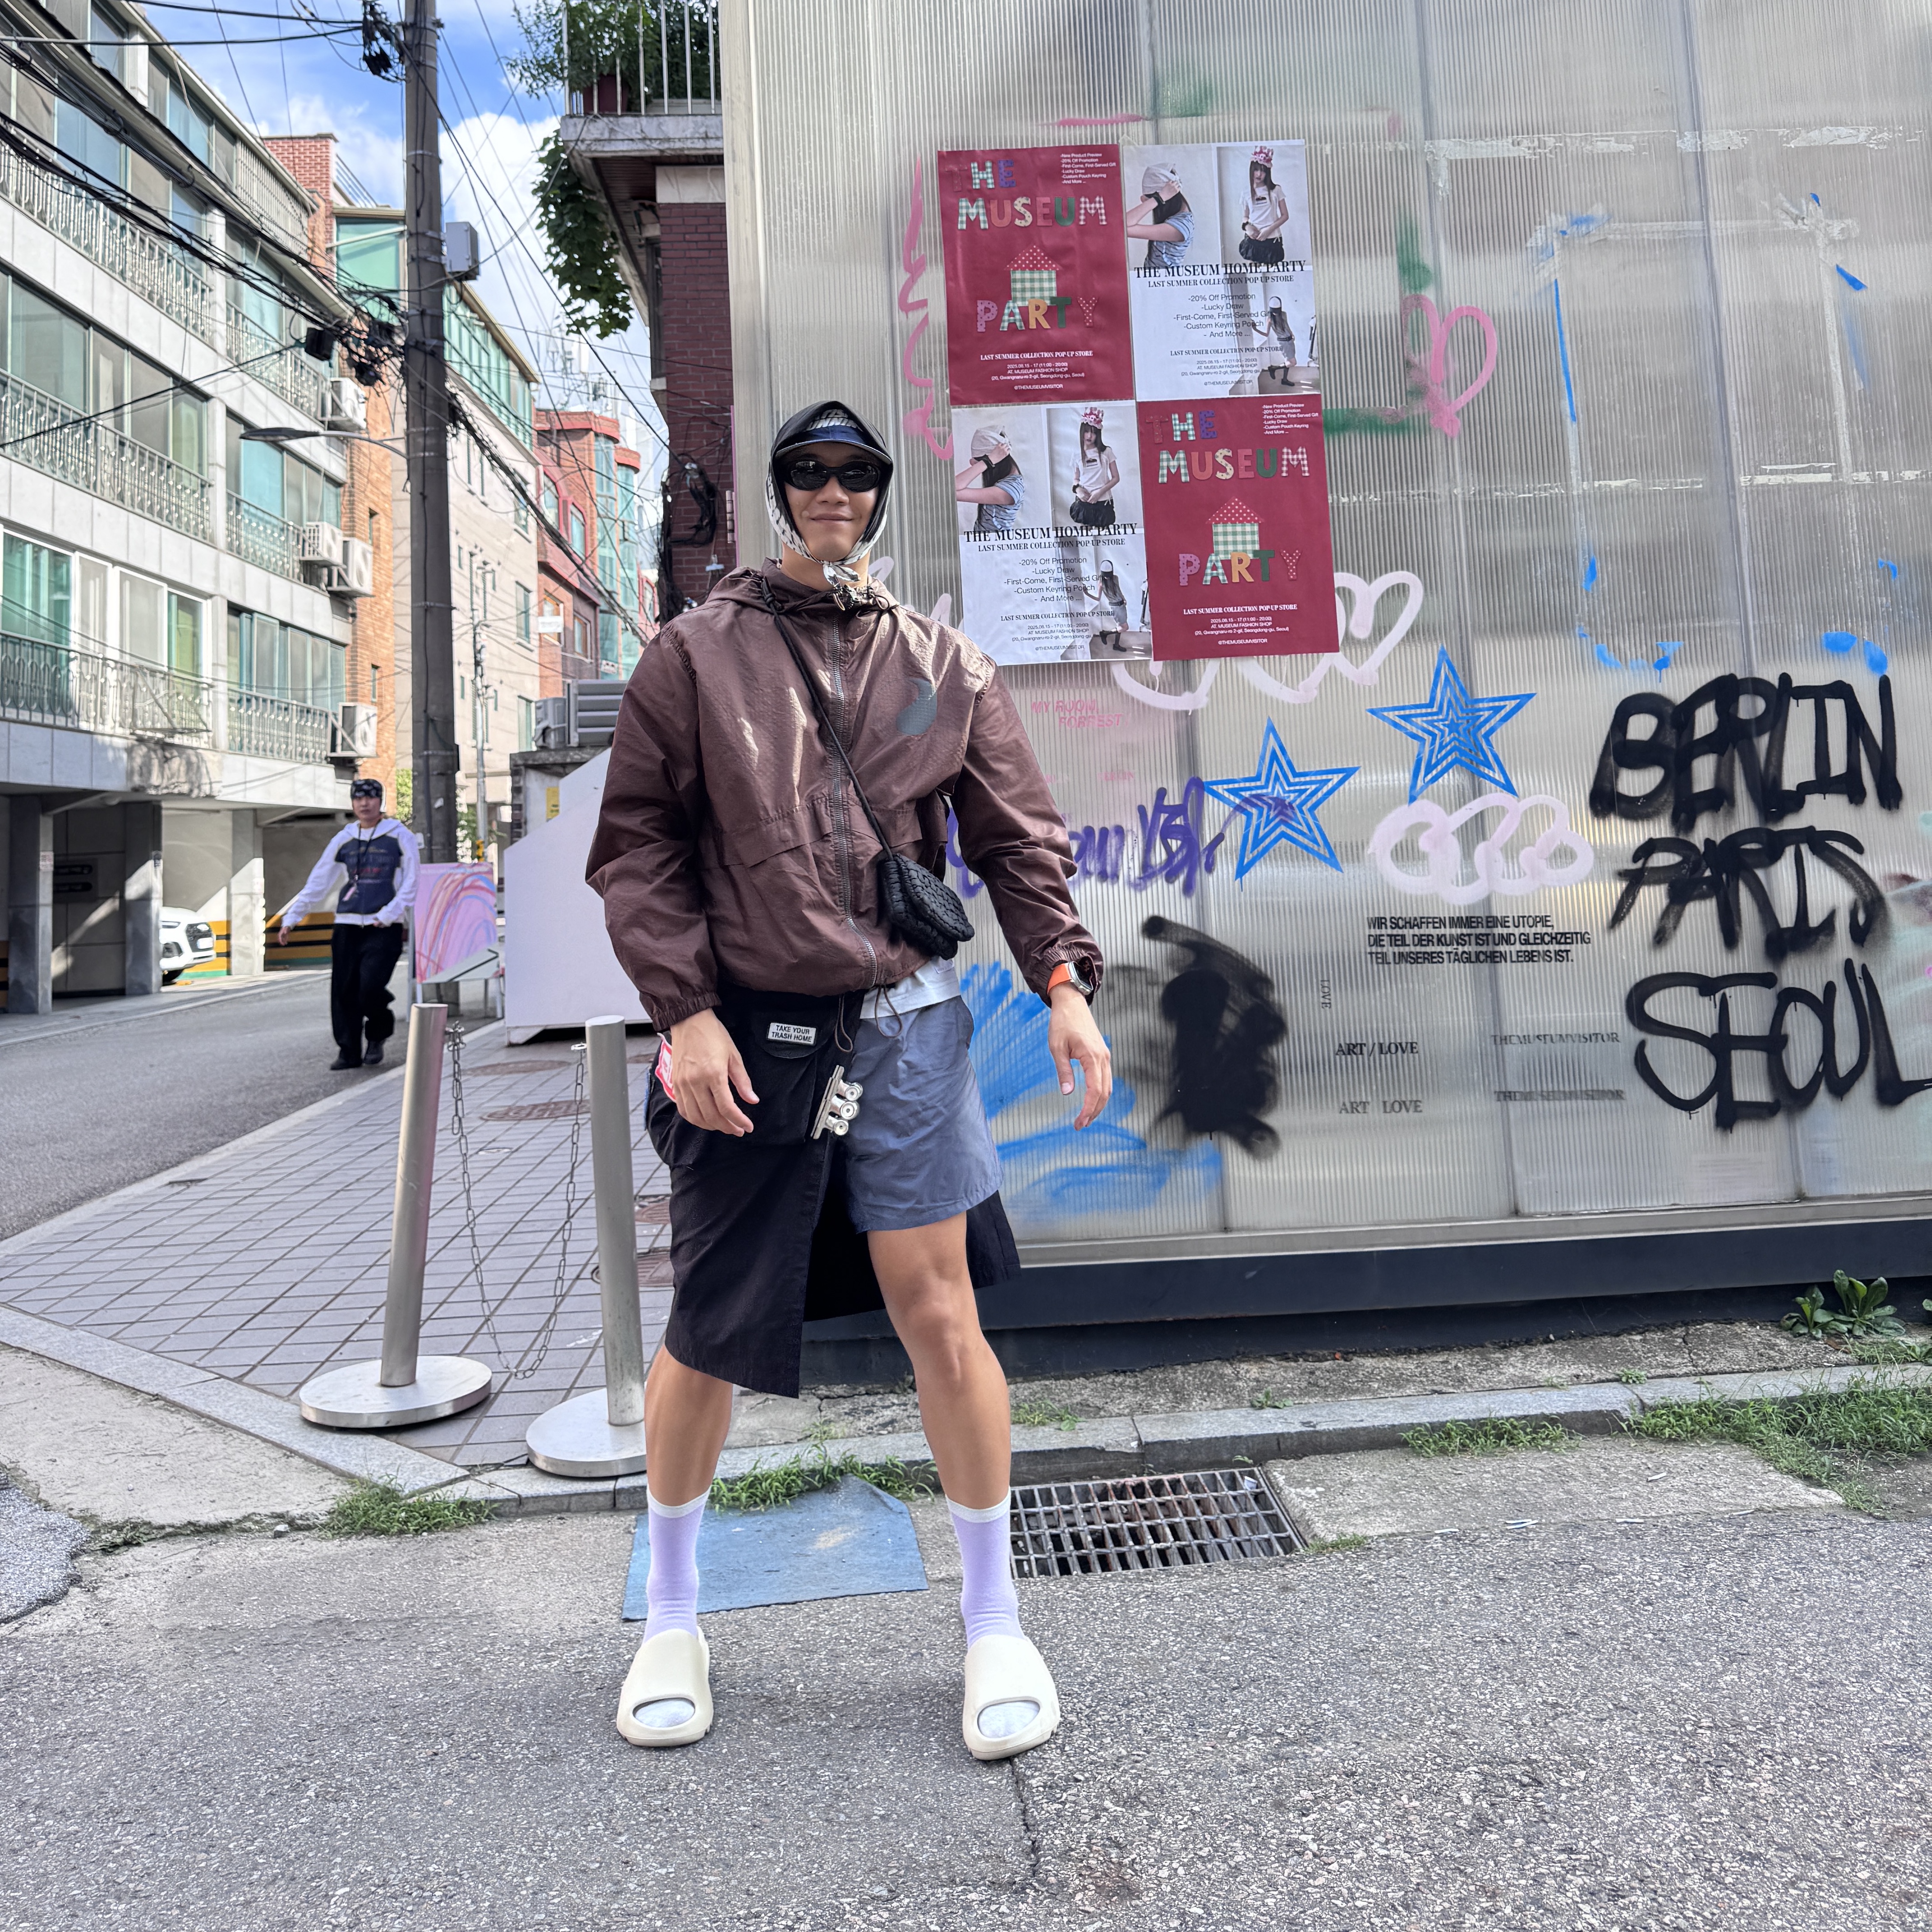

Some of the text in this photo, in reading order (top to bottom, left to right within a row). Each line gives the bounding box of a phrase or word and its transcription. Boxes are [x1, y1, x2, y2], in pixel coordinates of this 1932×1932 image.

[945, 160, 1016, 192] THE
[958, 196, 1107, 230] MUSEUM
[1134, 261, 1306, 278] THE MUSEUM HOME PARTY
[1166, 279, 1198, 287] SUMMER
[1199, 277, 1243, 286] COLLECTION
[1270, 275, 1294, 283] STORE
[976, 296, 1098, 332] PARTY
[1215, 321, 1240, 330] Keyring
[1145, 410, 1218, 444] THE
[1158, 446, 1310, 484] MUSEUM
[964, 523, 1138, 543] THE MUSEUM HOME PARTY
[996, 543, 1028, 551] SUMMER
[1030, 540, 1074, 549] COLLECTION
[1032, 567, 1055, 575] -Lucky
[1179, 549, 1301, 586] PARTY
[1046, 585, 1071, 594] Keyring
[1589, 672, 1903, 834] BERLIN
[1608, 826, 1891, 962] PARIS
[1367, 915, 1554, 929] WIR SCHAFFEN IMMER EINE UTOPIE,
[1368, 931, 1591, 947] DIE TEIL DER KUNST IST UND GLEICHZEITIG
[1368, 948, 1573, 964] TEIL UNSERES TÄGLICHEN LEBENS IST.
[1320, 980, 1331, 1009] LOVE
[772, 1031, 792, 1040] TRASH
[1336, 1043, 1366, 1055] ART
[1379, 1042, 1418, 1055] LOVE
[1627, 958, 1932, 1133] SEOUL
[1339, 1100, 1423, 1114] ART LOVE
